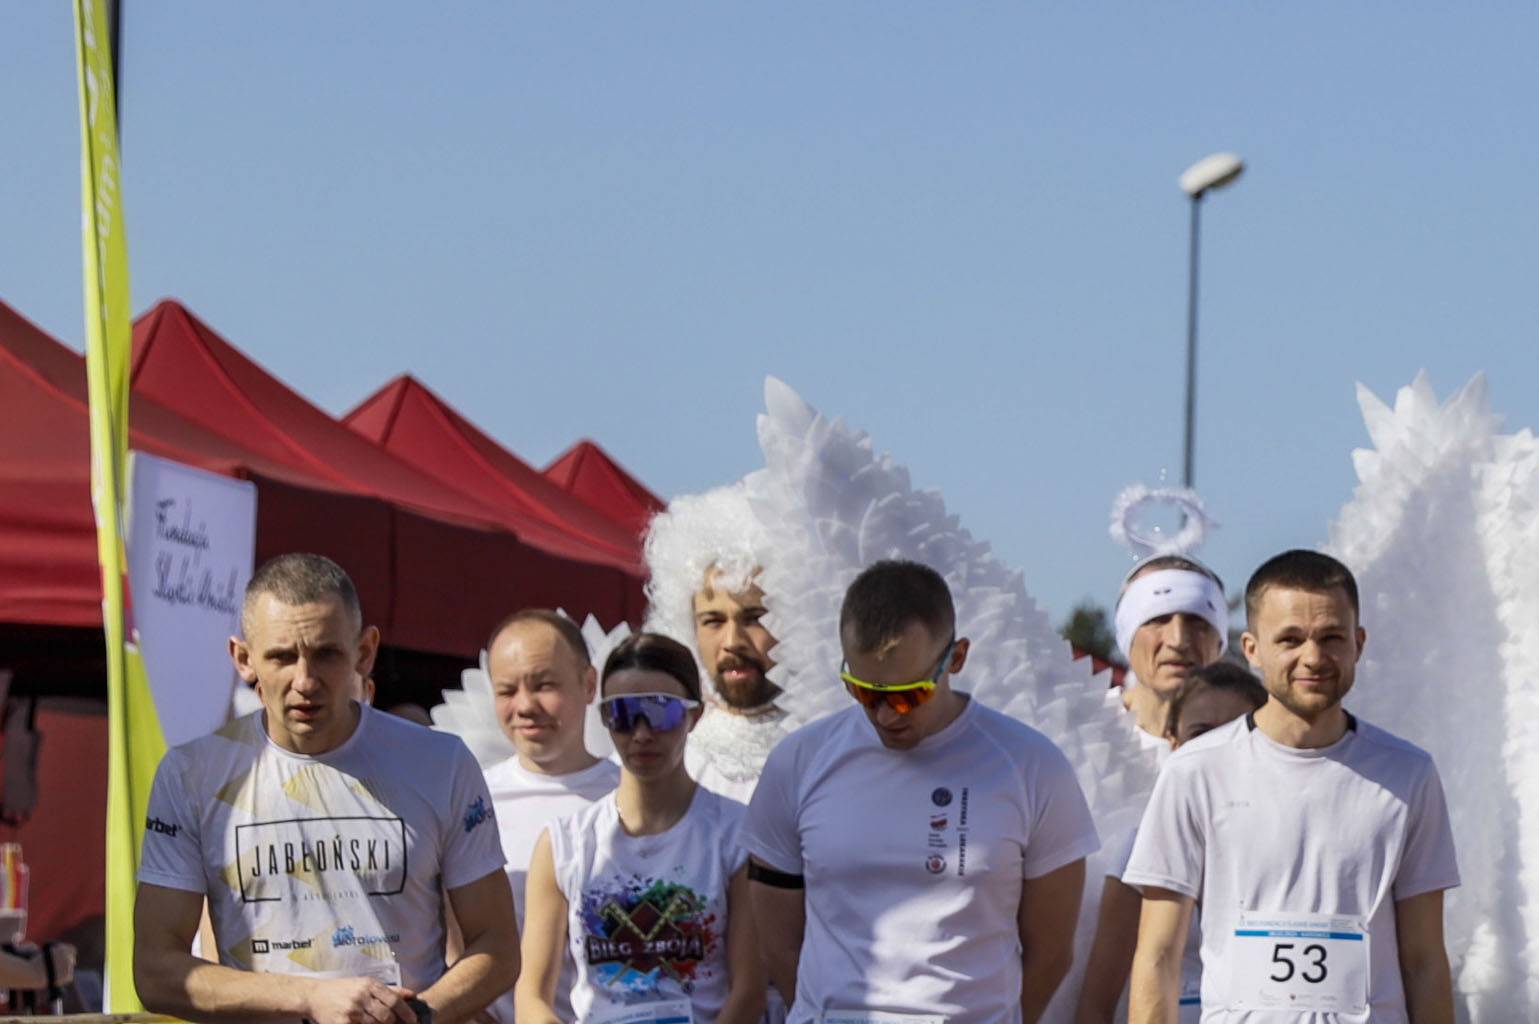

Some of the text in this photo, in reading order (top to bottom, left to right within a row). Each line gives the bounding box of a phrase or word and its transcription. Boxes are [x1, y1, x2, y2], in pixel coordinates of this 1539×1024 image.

[251, 834, 391, 878] JABŁOŃSKI
[590, 938, 632, 960] BIEG
[1270, 943, 1328, 984] 53
